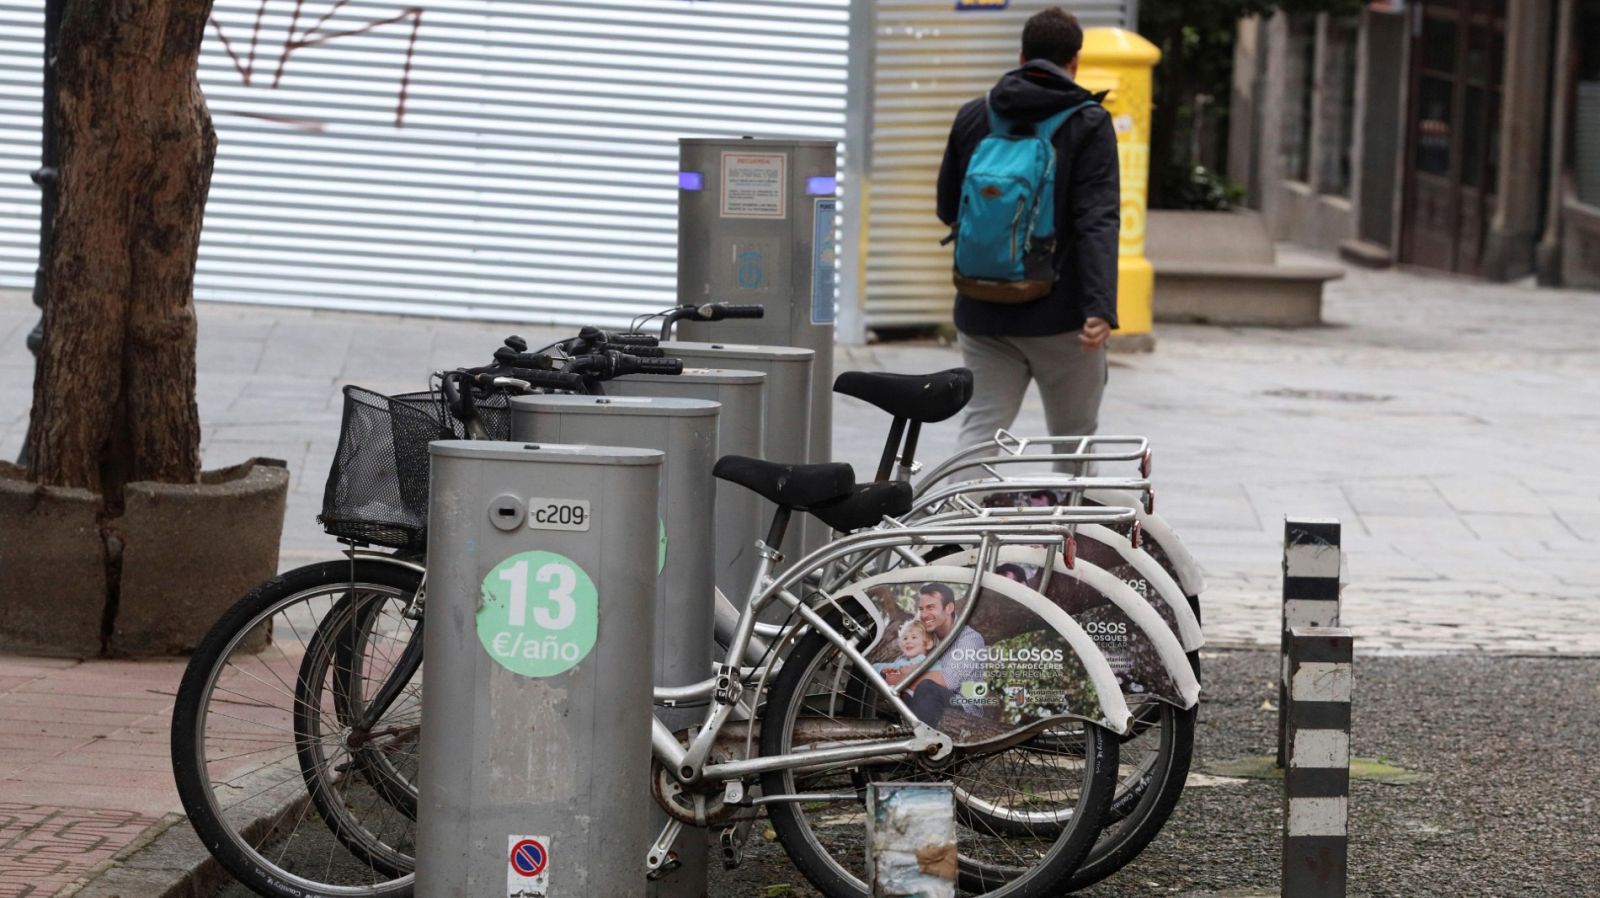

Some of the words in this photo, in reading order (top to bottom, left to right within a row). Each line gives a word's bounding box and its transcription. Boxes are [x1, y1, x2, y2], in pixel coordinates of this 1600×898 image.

[536, 504, 584, 525] c209
[499, 560, 577, 630] 13
[493, 631, 580, 662] €/año
[951, 648, 1064, 661] ORGULLOSOS
